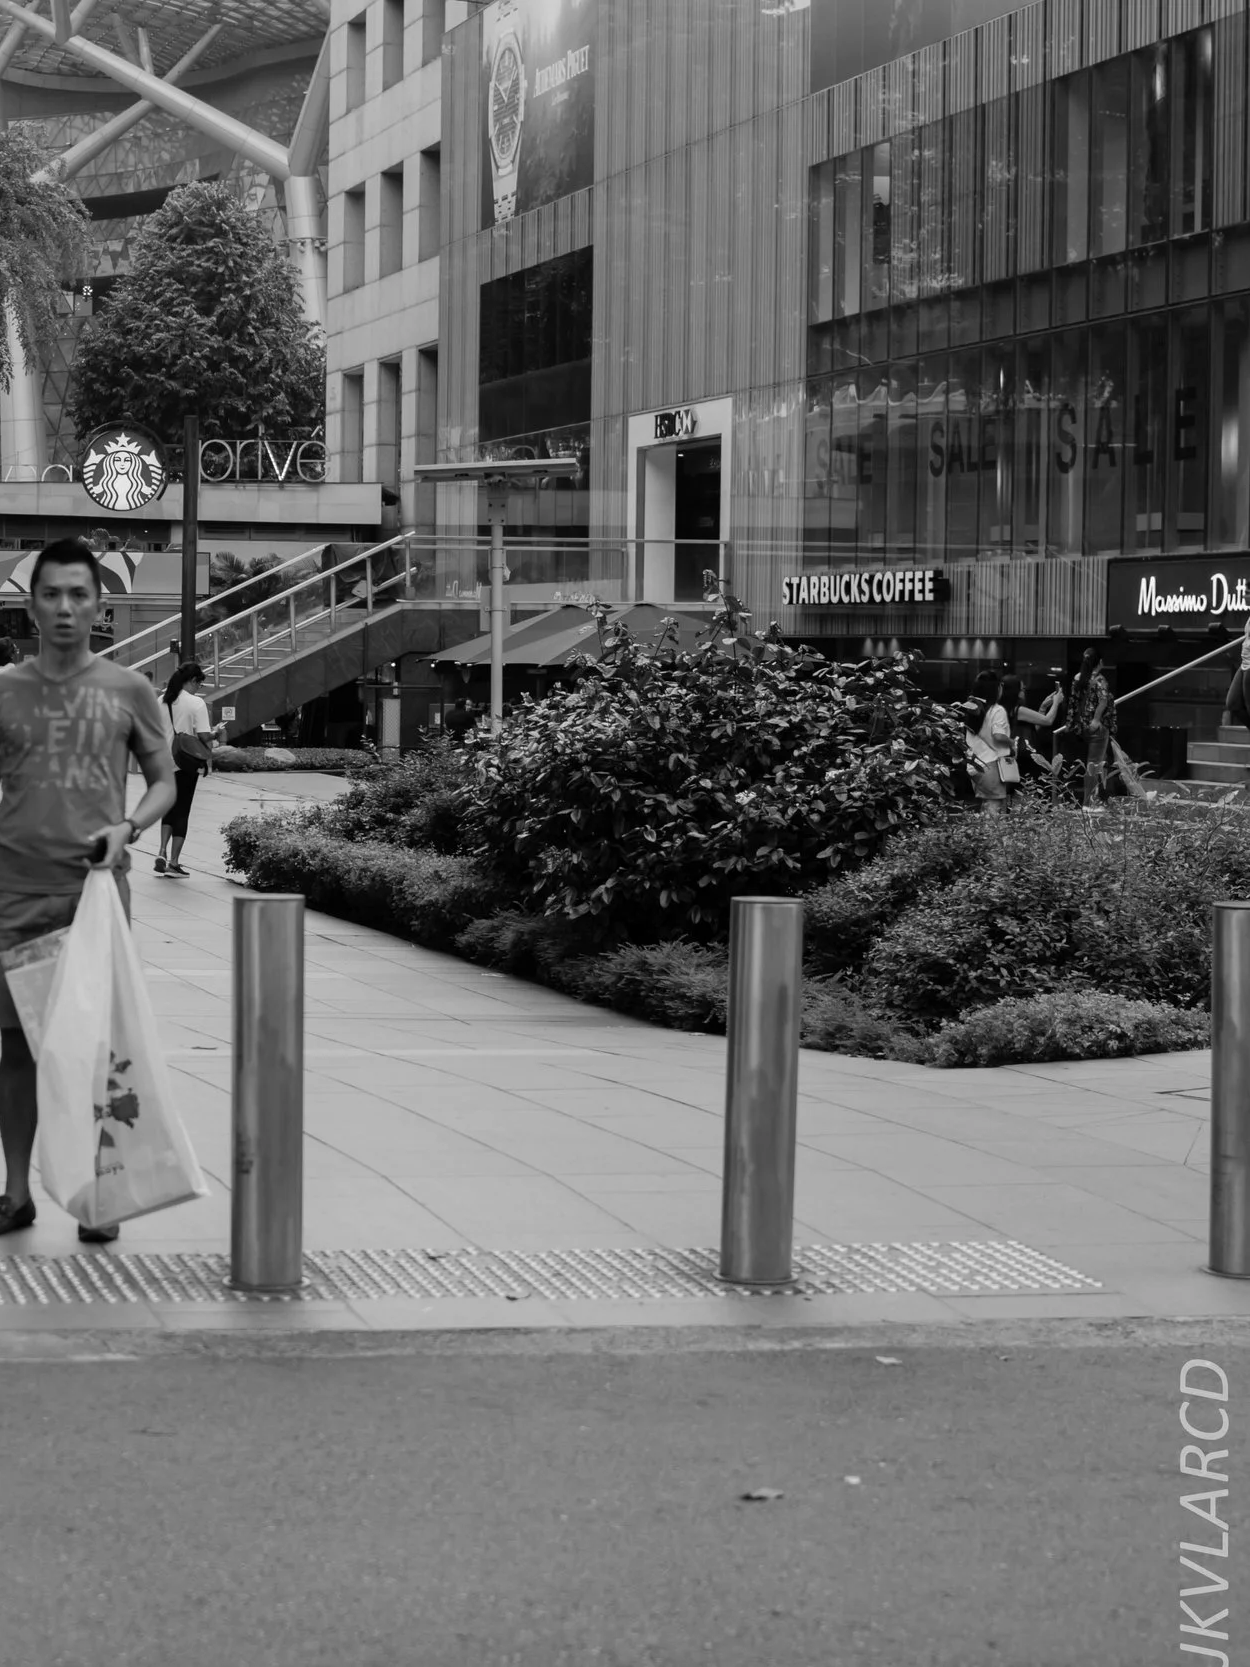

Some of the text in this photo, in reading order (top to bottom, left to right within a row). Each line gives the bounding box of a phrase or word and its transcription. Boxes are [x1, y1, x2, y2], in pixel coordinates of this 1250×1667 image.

[928, 418, 997, 478] SALE
[1055, 385, 1197, 475] SALE
[782, 571, 934, 605] STARBUCKS COFFEE
[1137, 572, 1250, 616] Massimo Dutt
